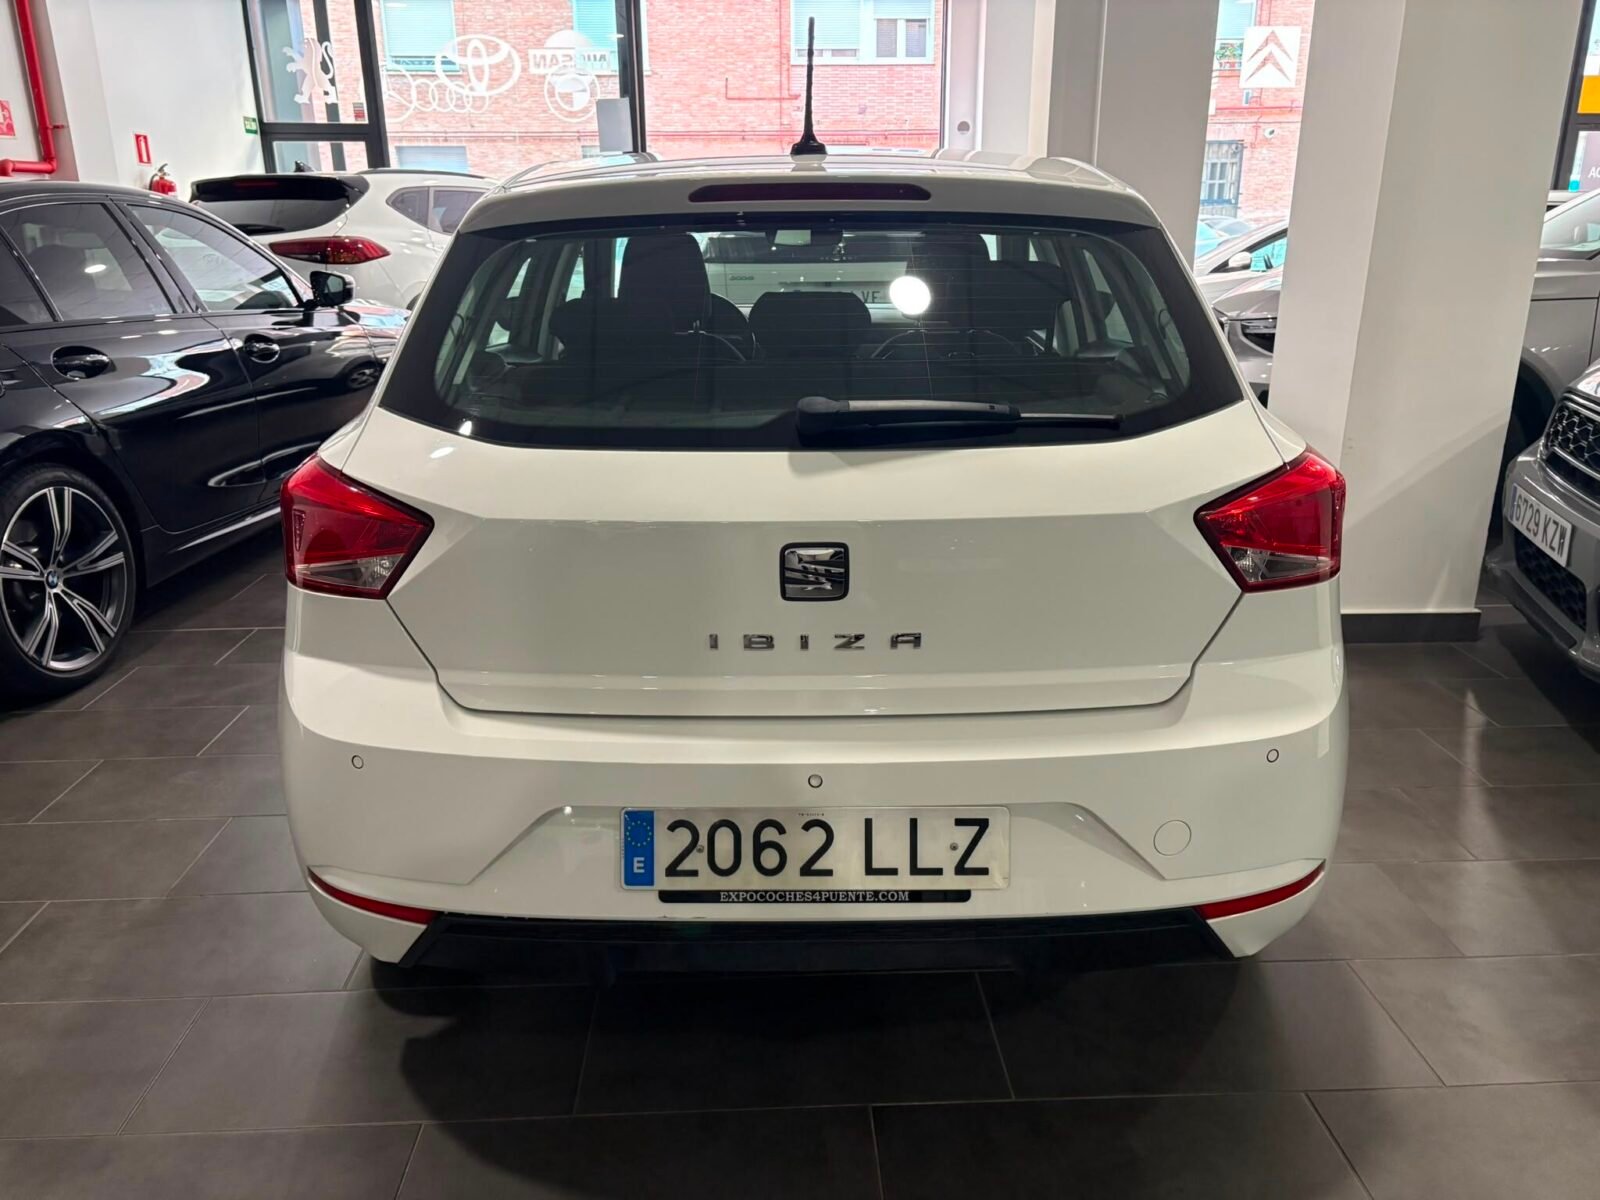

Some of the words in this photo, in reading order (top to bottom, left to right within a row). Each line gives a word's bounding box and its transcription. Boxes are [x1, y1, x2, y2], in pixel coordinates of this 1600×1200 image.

[1515, 494, 1541, 537] 6729
[1541, 514, 1567, 557] KZW
[709, 633, 922, 650] IBIZA
[665, 819, 834, 877] 2062
[864, 818, 989, 876] LLZ
[633, 857, 645, 873] E
[720, 891, 909, 902] EXPOCOCHES4PUENTE.COM
